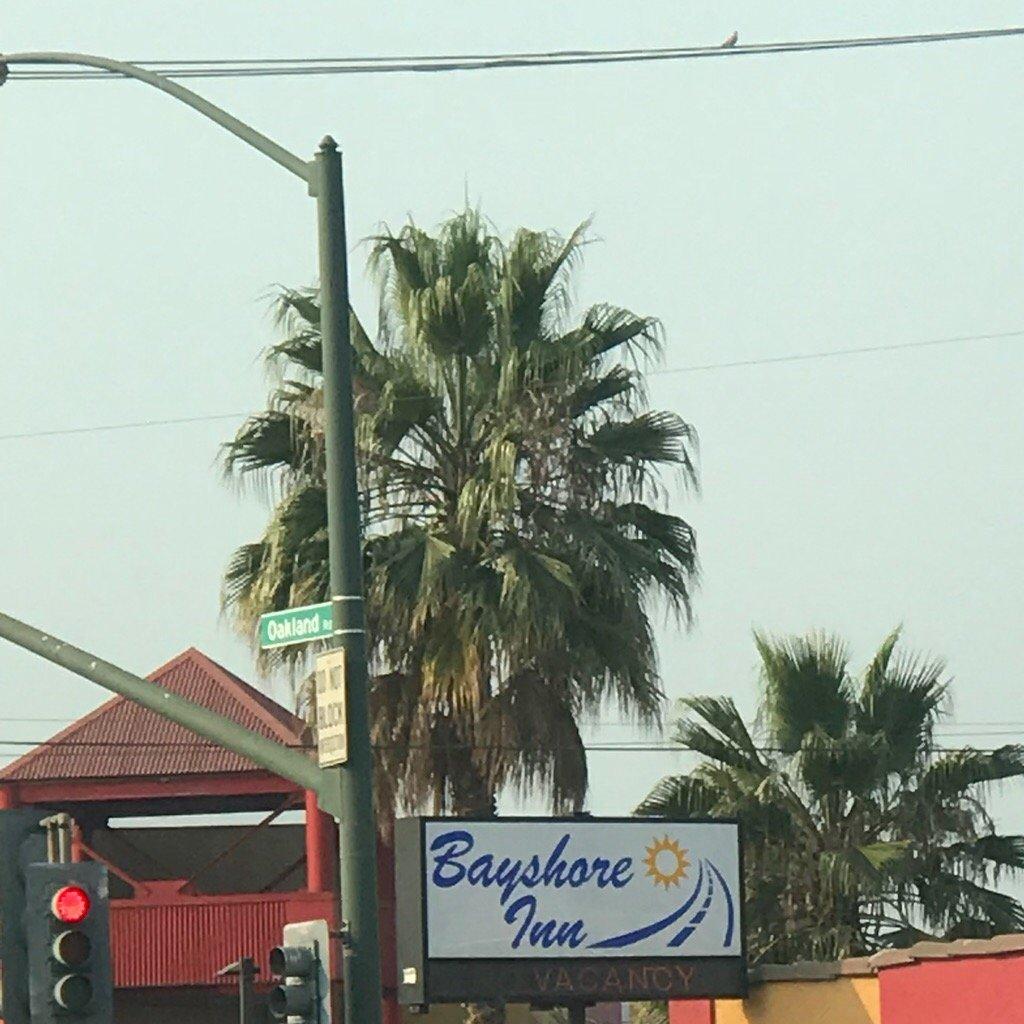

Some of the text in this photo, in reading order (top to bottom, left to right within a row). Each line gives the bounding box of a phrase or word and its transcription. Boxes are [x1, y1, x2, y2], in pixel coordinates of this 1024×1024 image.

[268, 613, 320, 642] Oakland
[429, 830, 636, 905] Bayshore
[503, 895, 588, 950] Inn
[532, 965, 697, 994] VACANCY
